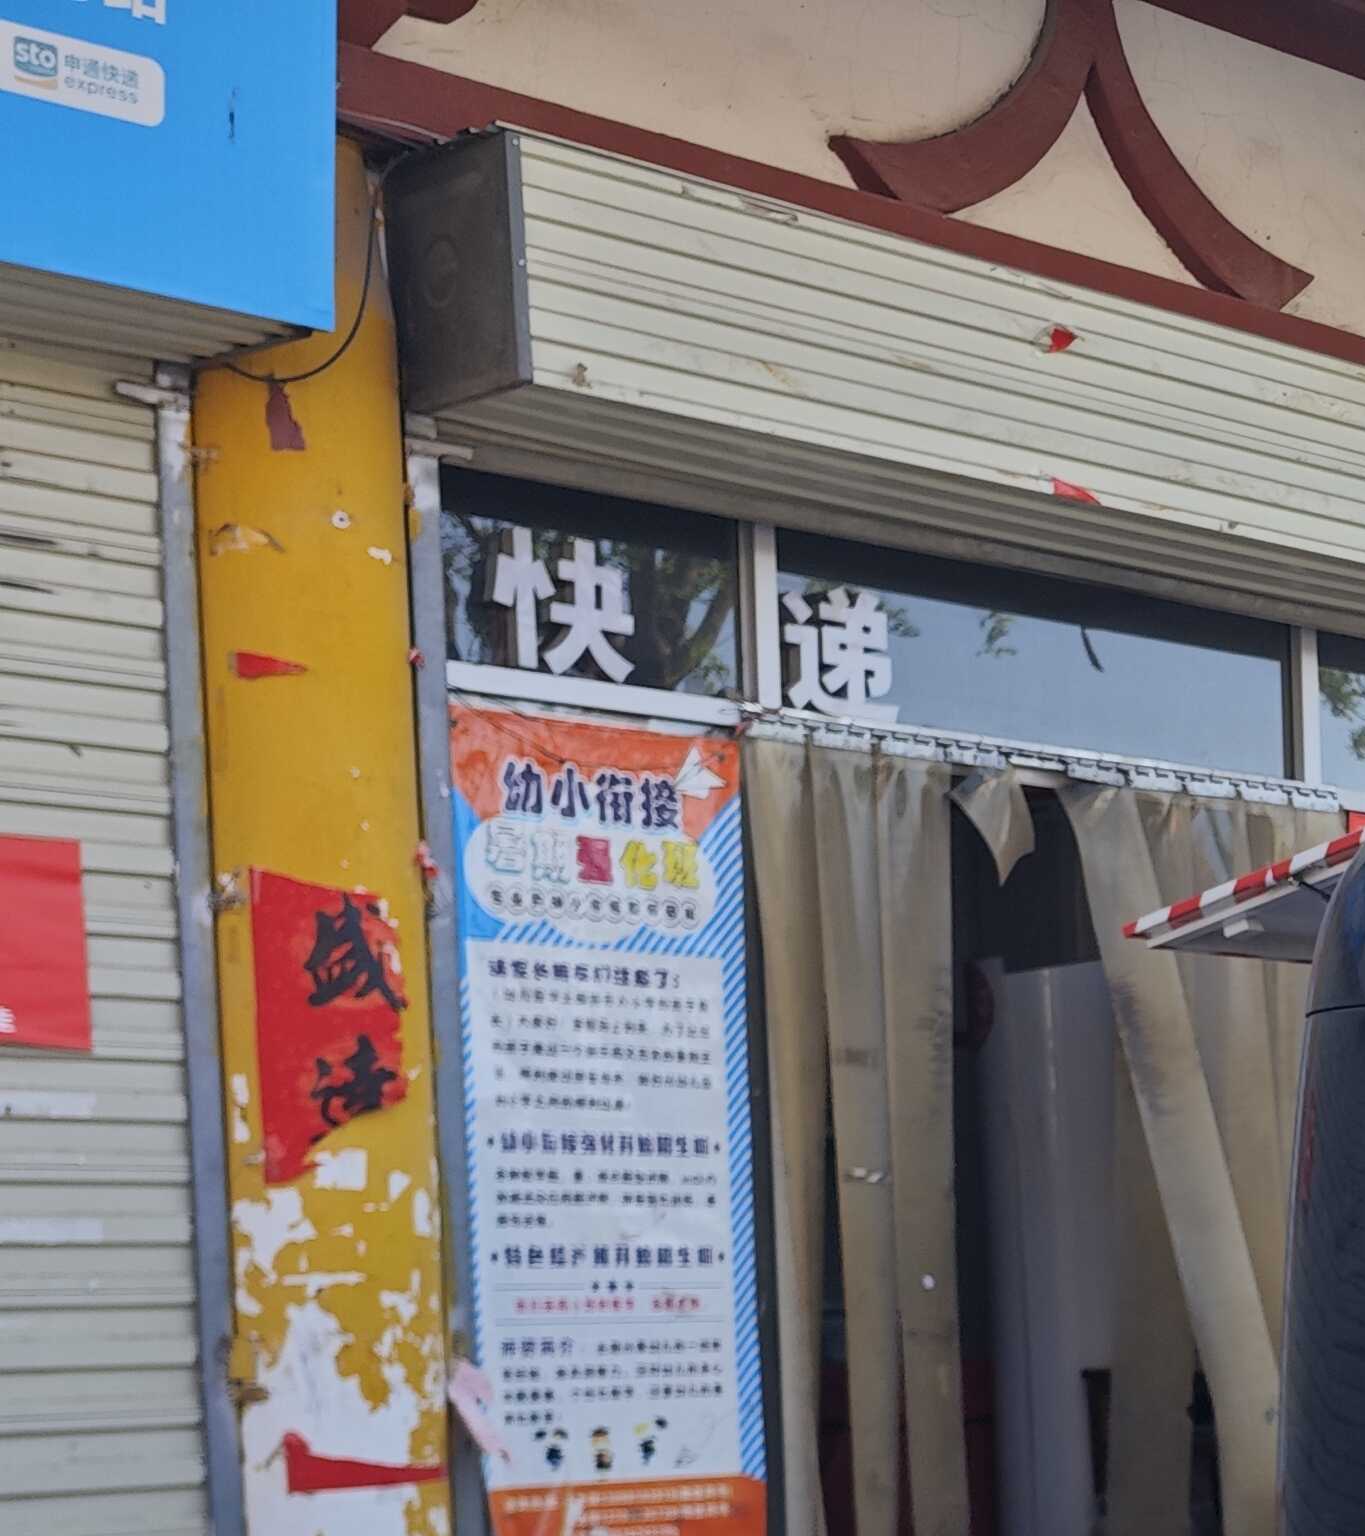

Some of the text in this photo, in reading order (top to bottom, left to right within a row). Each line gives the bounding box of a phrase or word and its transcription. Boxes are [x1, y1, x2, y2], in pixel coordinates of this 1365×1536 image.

[15, 41, 56, 69] sto
[64, 54, 139, 89] 申通快递
[64, 76, 139, 104] express
[493, 526, 899, 723] 快递
[503, 761, 679, 830] 幼小衔接
